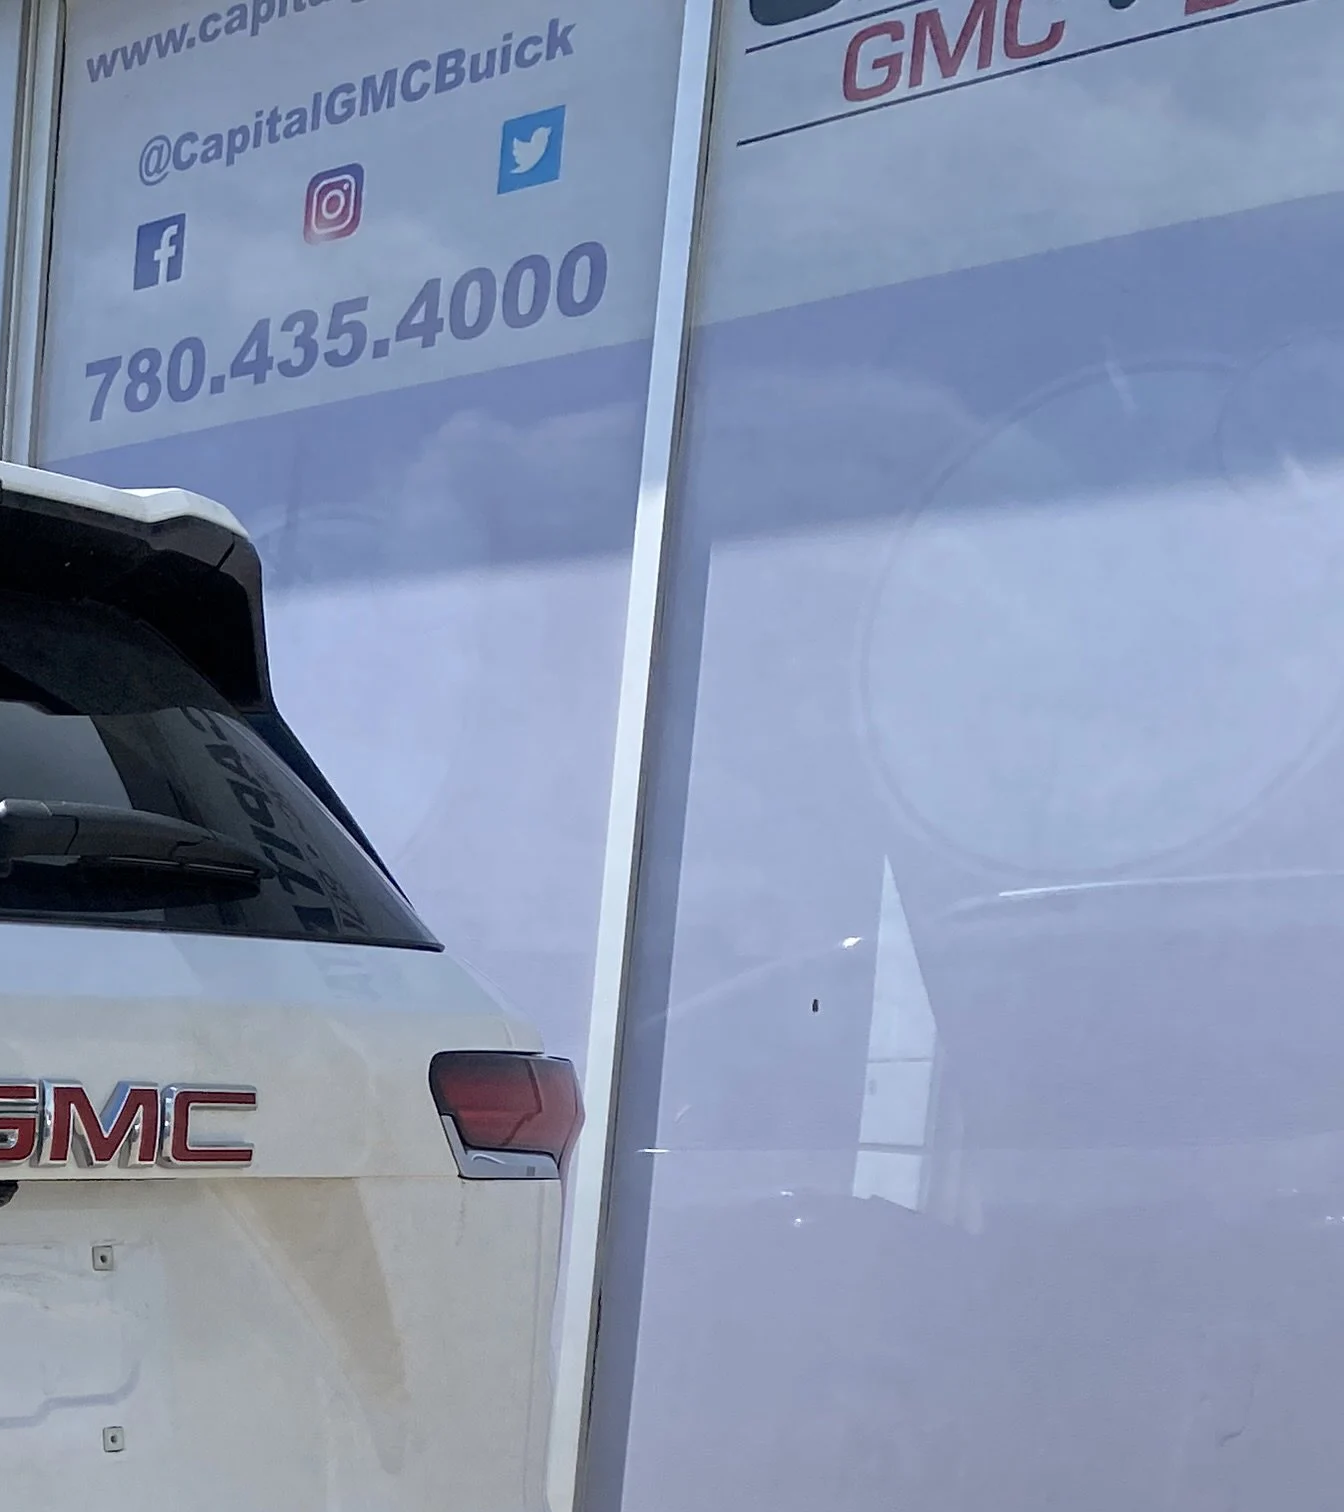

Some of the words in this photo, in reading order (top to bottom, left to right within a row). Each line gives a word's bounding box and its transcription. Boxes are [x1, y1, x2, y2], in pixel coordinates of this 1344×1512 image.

[138, 17, 576, 187] @CapitalGMCBuick
[842, 0, 1067, 102] GMC
[84, 241, 608, 423] 780.435.4000
